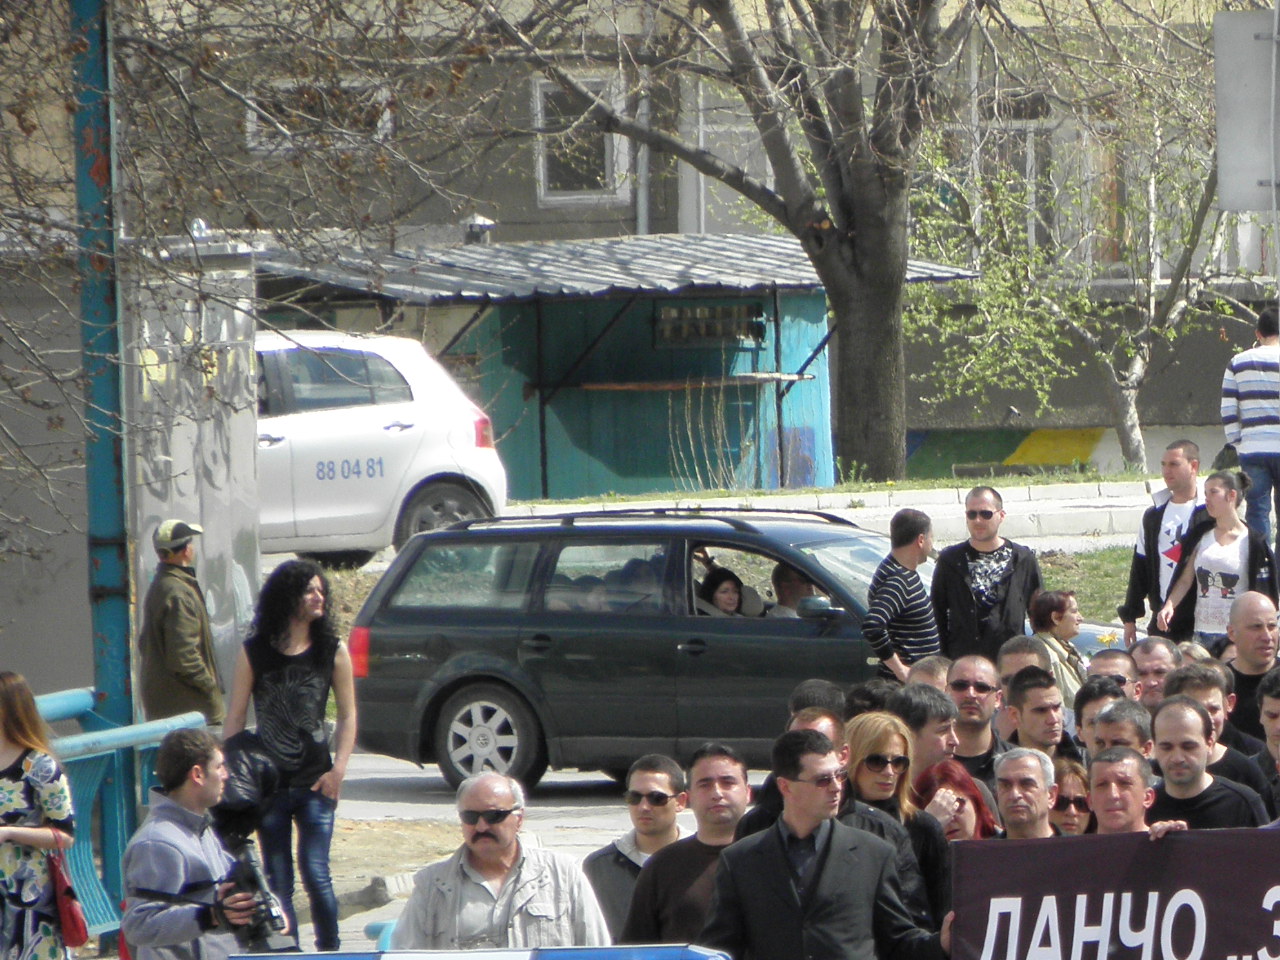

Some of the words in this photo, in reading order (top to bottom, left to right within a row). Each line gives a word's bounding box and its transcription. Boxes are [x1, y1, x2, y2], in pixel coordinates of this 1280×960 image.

[316, 461, 335, 480] 88
[341, 459, 361, 479] 04
[366, 456, 384, 478] 81
